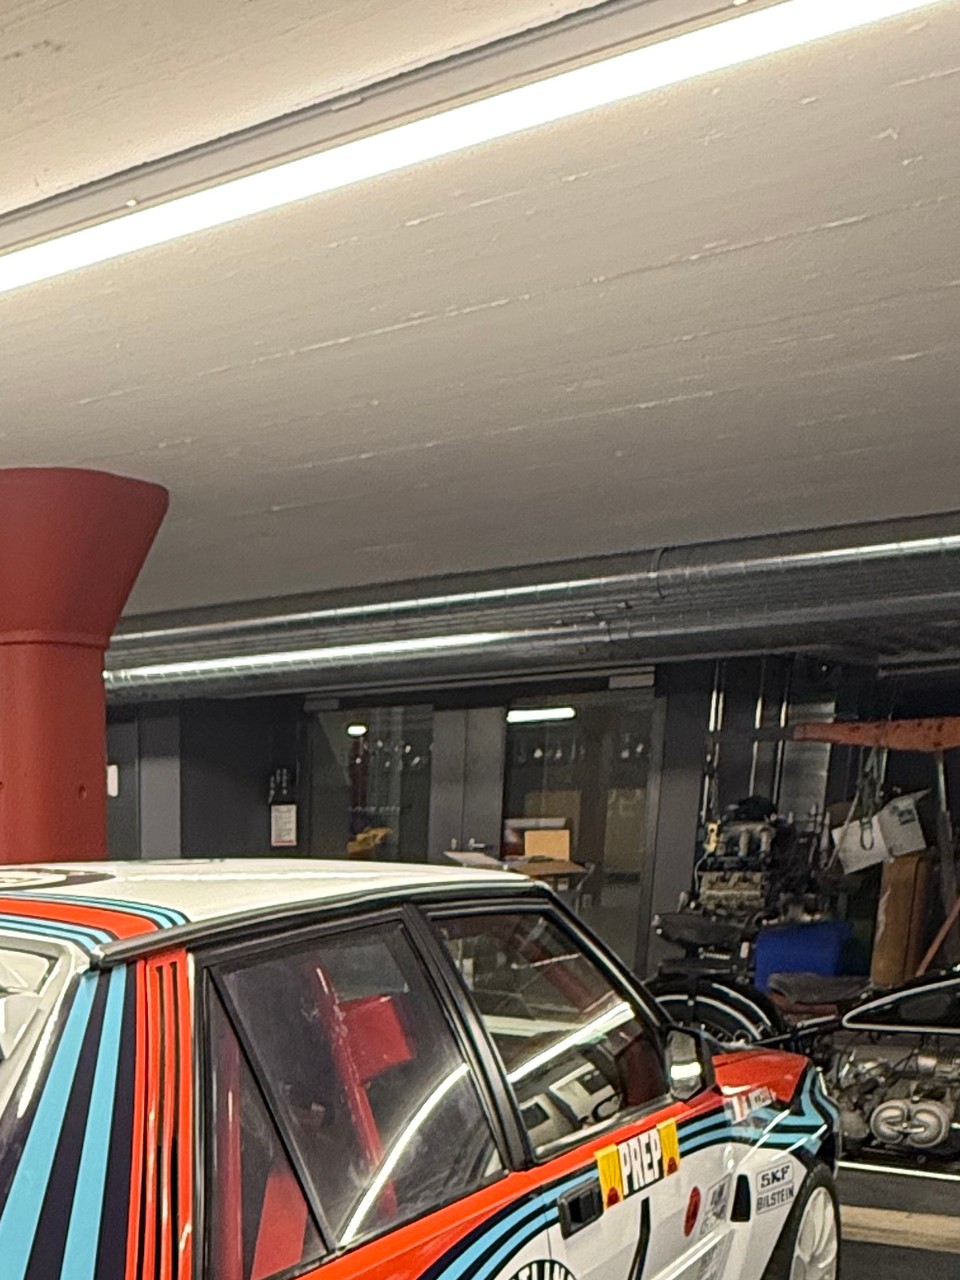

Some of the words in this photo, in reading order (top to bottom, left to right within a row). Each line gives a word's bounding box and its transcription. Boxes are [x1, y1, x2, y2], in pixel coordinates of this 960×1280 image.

[619, 1128, 662, 1196] PREP
[760, 1164, 790, 1189] SKF
[756, 1184, 794, 1211] BILSTEIN
